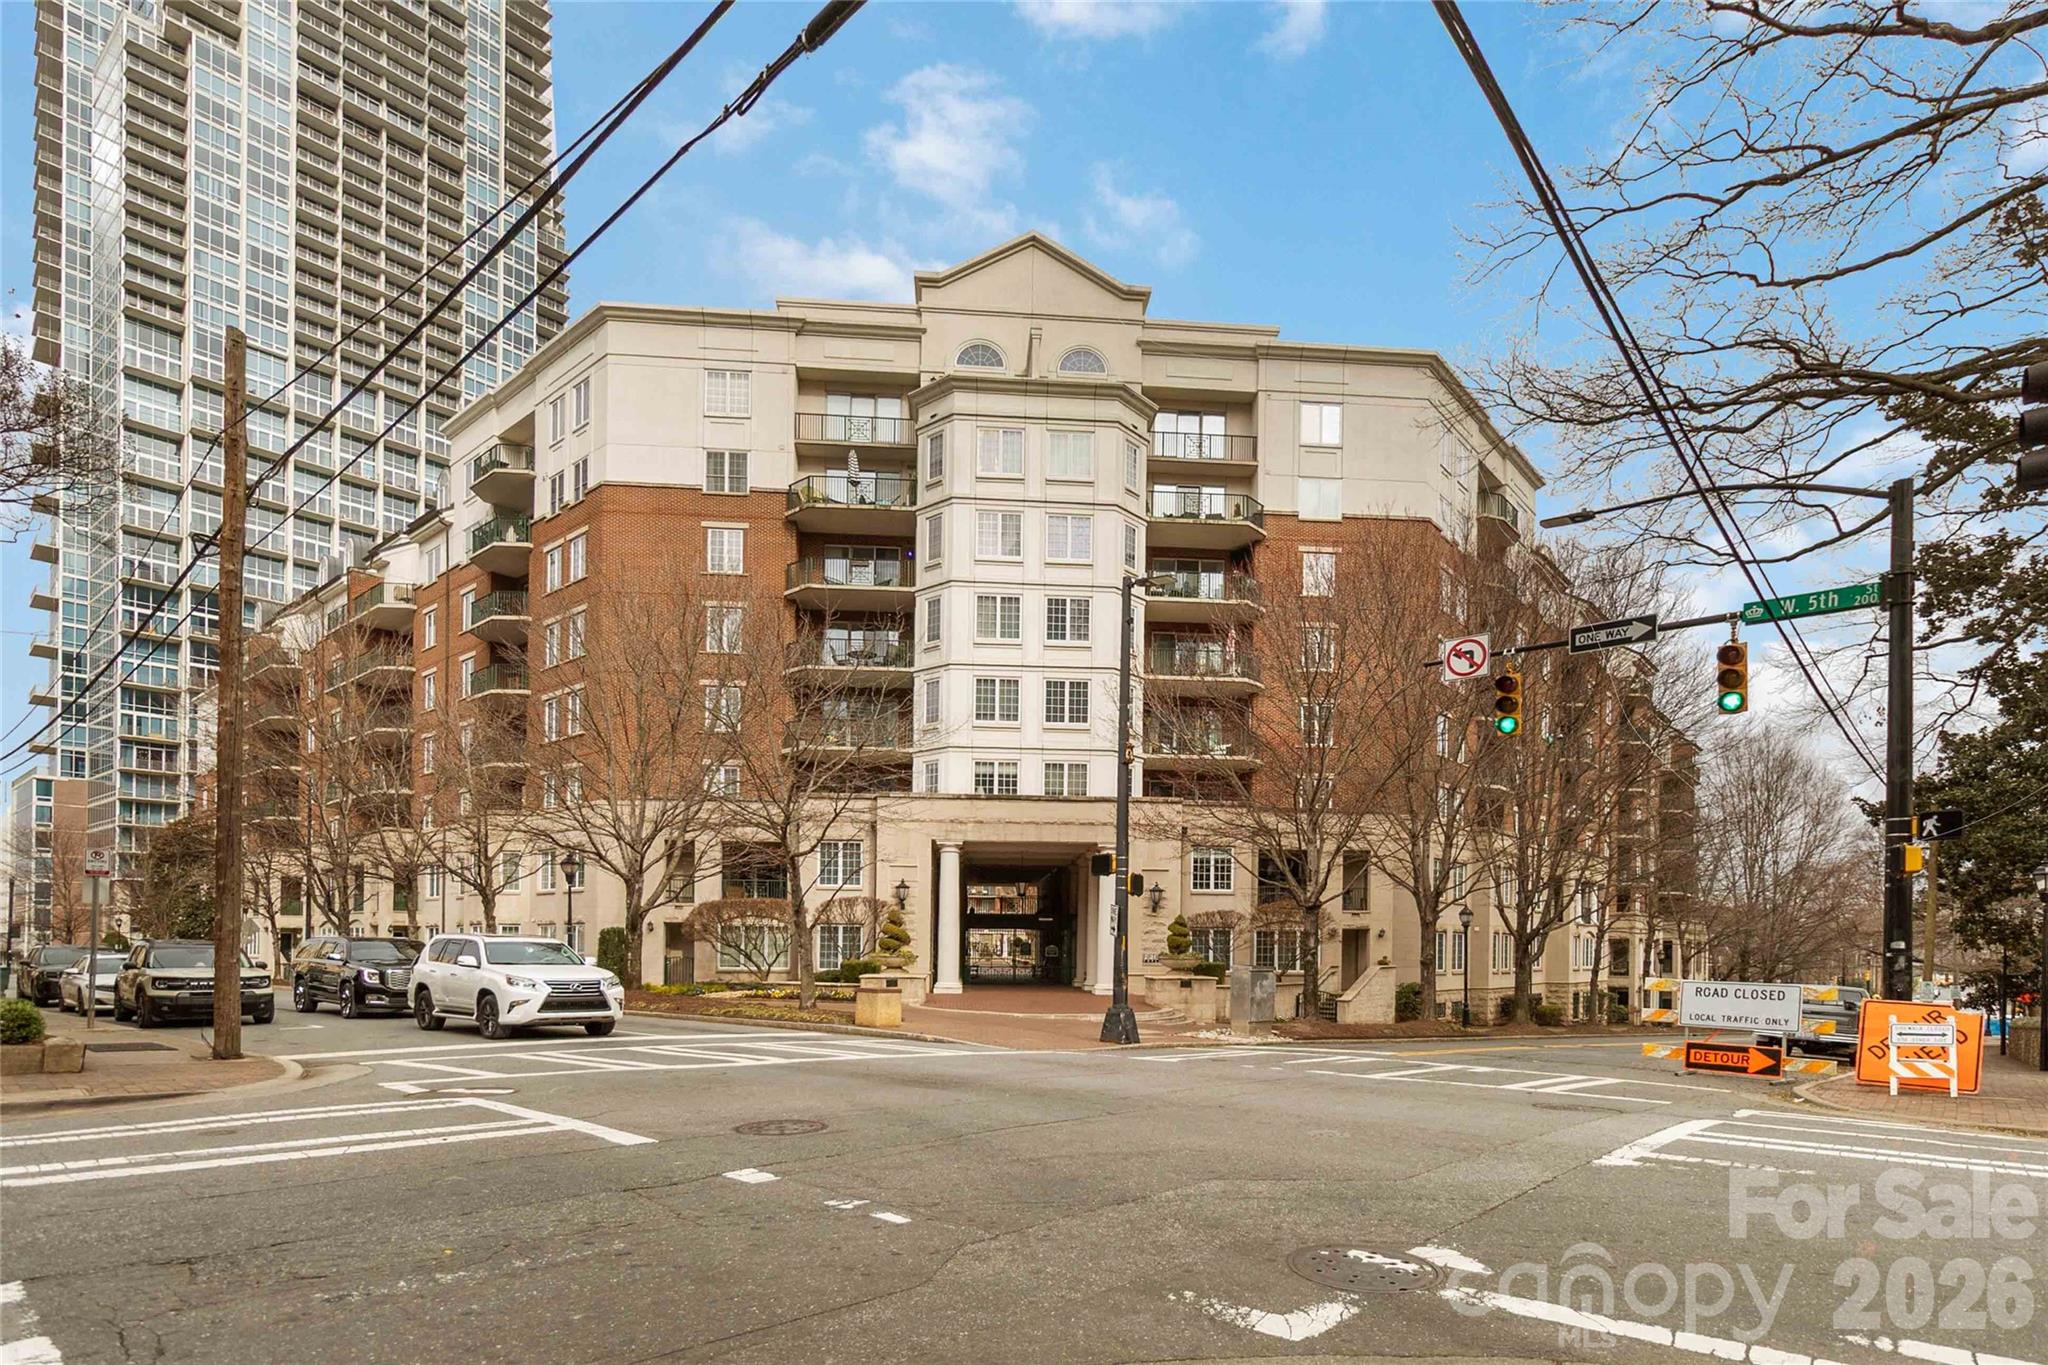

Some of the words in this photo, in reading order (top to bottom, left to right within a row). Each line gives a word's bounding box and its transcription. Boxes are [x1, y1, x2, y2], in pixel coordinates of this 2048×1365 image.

[1808, 592, 1838, 610] 5th
[1866, 584, 1879, 594] St
[1854, 594, 1879, 606] 200
[1578, 632, 1601, 644] ONE
[1605, 627, 1630, 639] WAY
[1695, 987, 1728, 998] ROAD
[1734, 989, 1786, 1001] CLOSED
[1689, 1013, 1716, 1022] LOCAL
[1722, 1015, 1759, 1025] TRAFFIC
[1765, 1017, 1790, 1026] ONLY
[1693, 1051, 1750, 1065] DETOUR
